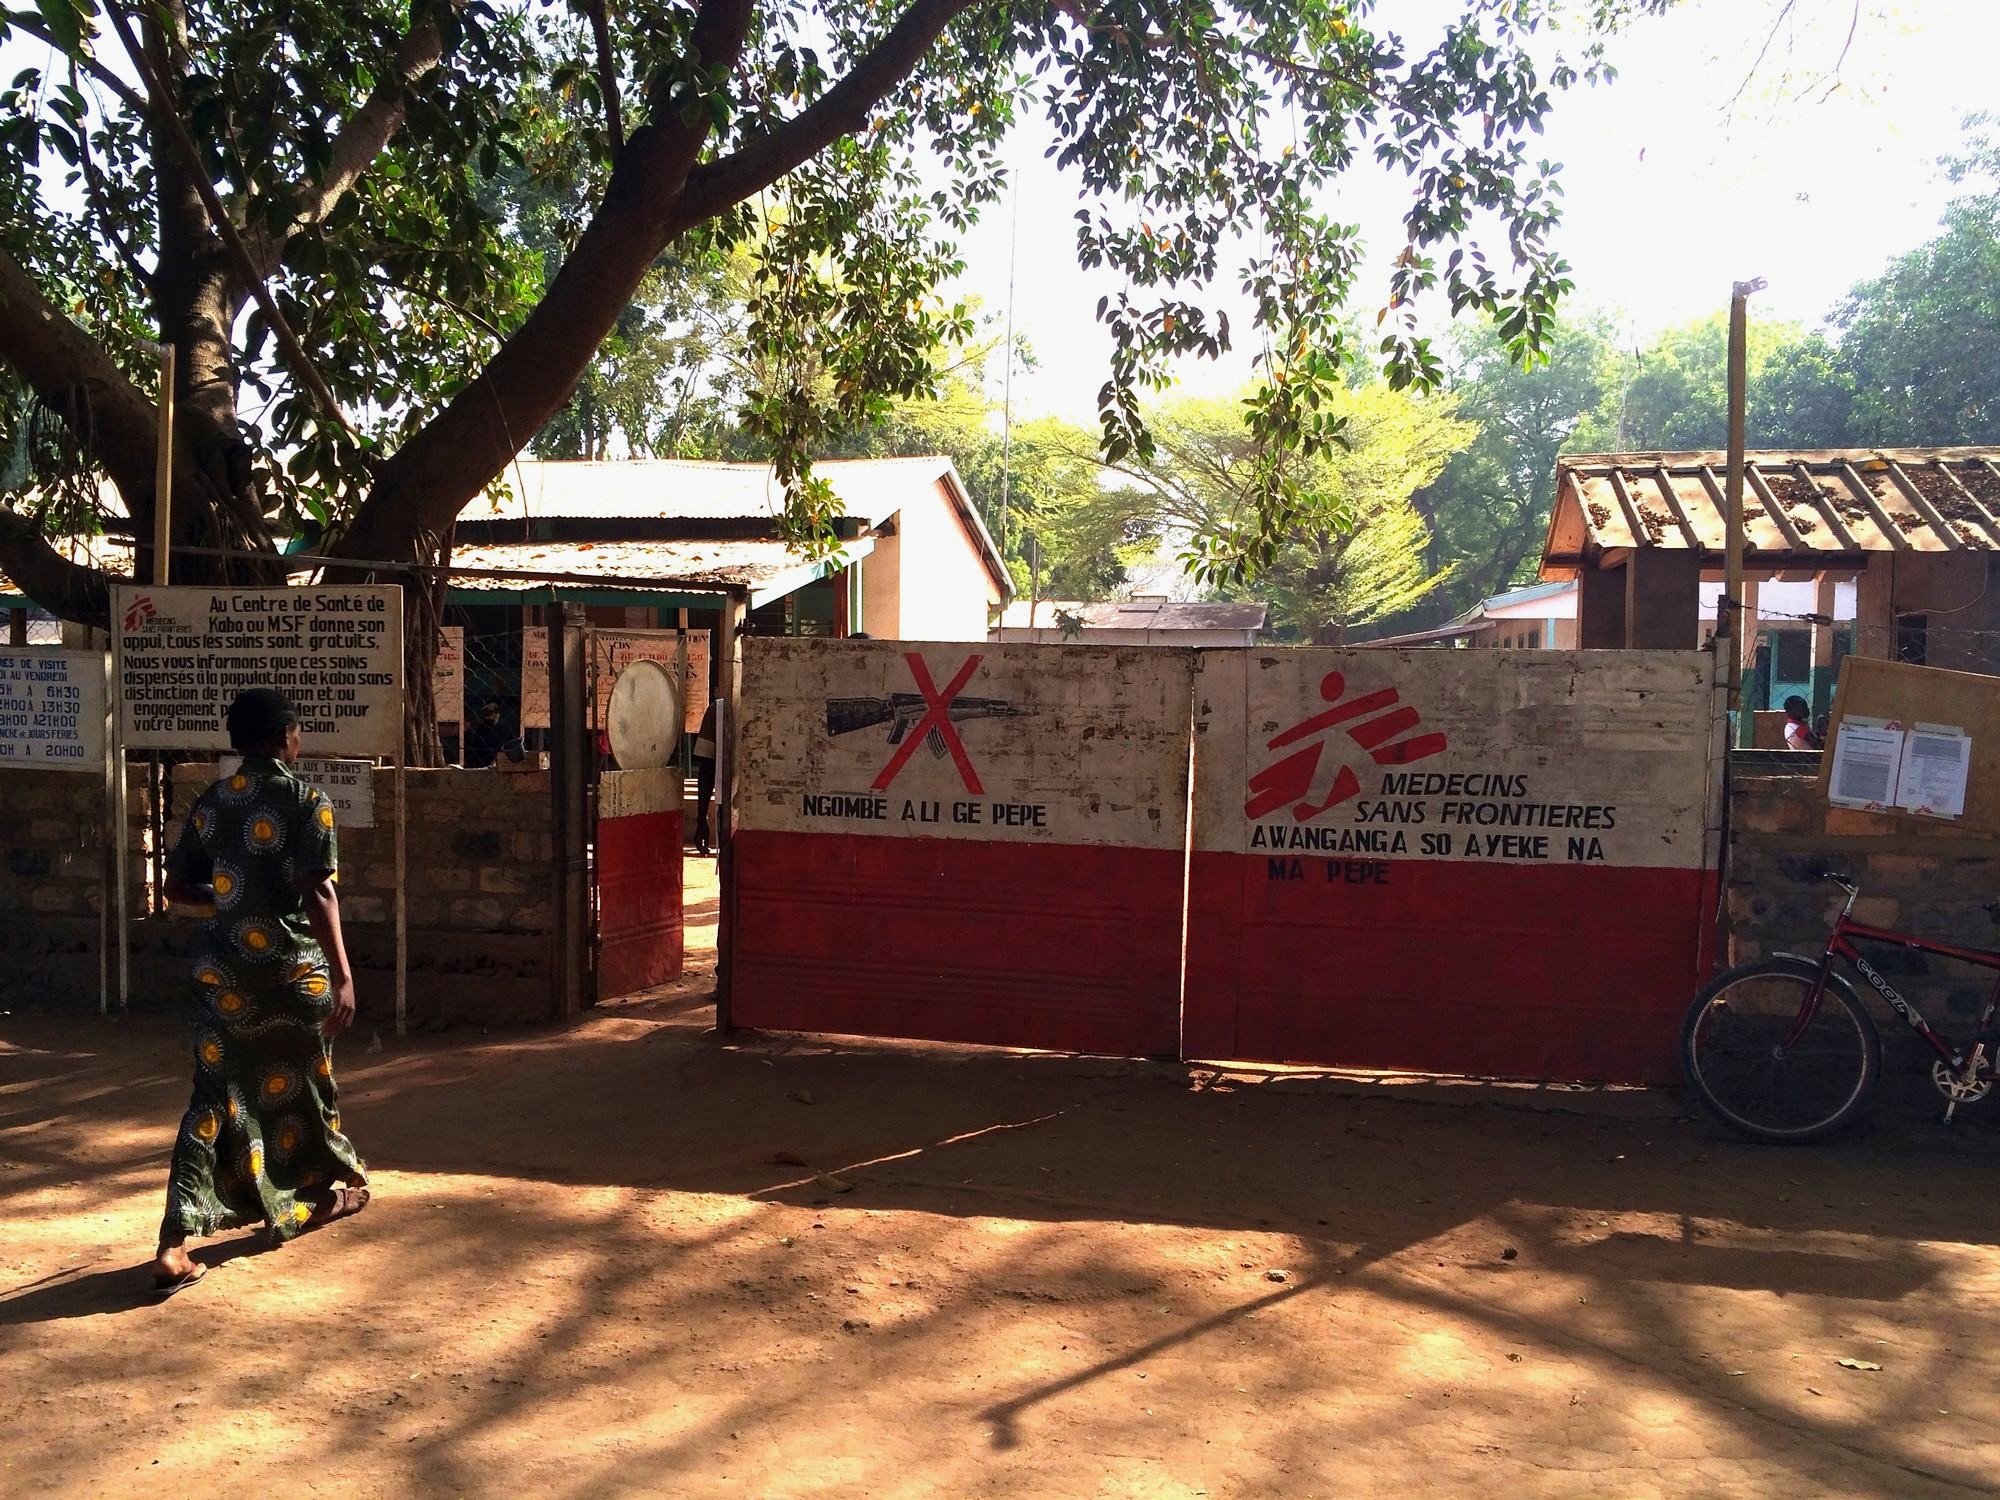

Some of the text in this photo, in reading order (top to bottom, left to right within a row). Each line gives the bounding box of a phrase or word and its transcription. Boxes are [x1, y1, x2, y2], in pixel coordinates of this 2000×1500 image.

[210, 595, 385, 612] Au Centre de Santé de
[209, 615, 385, 633] Kabo ou MSF donne son
[203, 634, 223, 649] les
[226, 633, 263, 649] soins
[267, 635, 302, 649] sont
[309, 634, 380, 652] gratuits,
[21, 660, 31, 669] DE
[39, 660, 67, 670] VISITE
[124, 655, 159, 669] Nous
[162, 656, 194, 669] vous
[196, 654, 267, 669] informons
[270, 656, 297, 672] que
[301, 656, 327, 669] ces
[10, 672, 21, 681] AU
[25, 672, 67, 682] VENDREDI
[124, 670, 194, 688] dispensés
[205, 670, 217, 685] la
[221, 670, 296, 687] population
[300, 670, 317, 685] de
[358, 672, 393, 686] sans
[27, 686, 33, 697] A
[46, 687, 80, 698] 6H30
[124, 686, 198, 701] distinction
[202, 686, 218, 701] de
[41, 701, 80, 714] 13H30
[134, 702, 217, 718] engagement
[335, 704, 370, 718] pour
[134, 718, 173, 732] votre
[177, 717, 219, 732] bonne
[26, 744, 31, 756] A
[46, 745, 84, 757] 20H00
[303, 763, 319, 773] AUX
[325, 763, 361, 774] ENFANTS
[313, 774, 324, 784] DE
[341, 775, 357, 785] ANS
[1380, 773, 1527, 797] MEDECINS
[803, 795, 887, 819] NGOMBE
[953, 802, 981, 824] GE
[992, 803, 1046, 826] PEPE
[1354, 801, 1616, 829] SANS FRONTIERES
[1250, 825, 1604, 860] AWANGANGA SO AYEKE NA
[1268, 858, 1390, 885] MA PEPE
